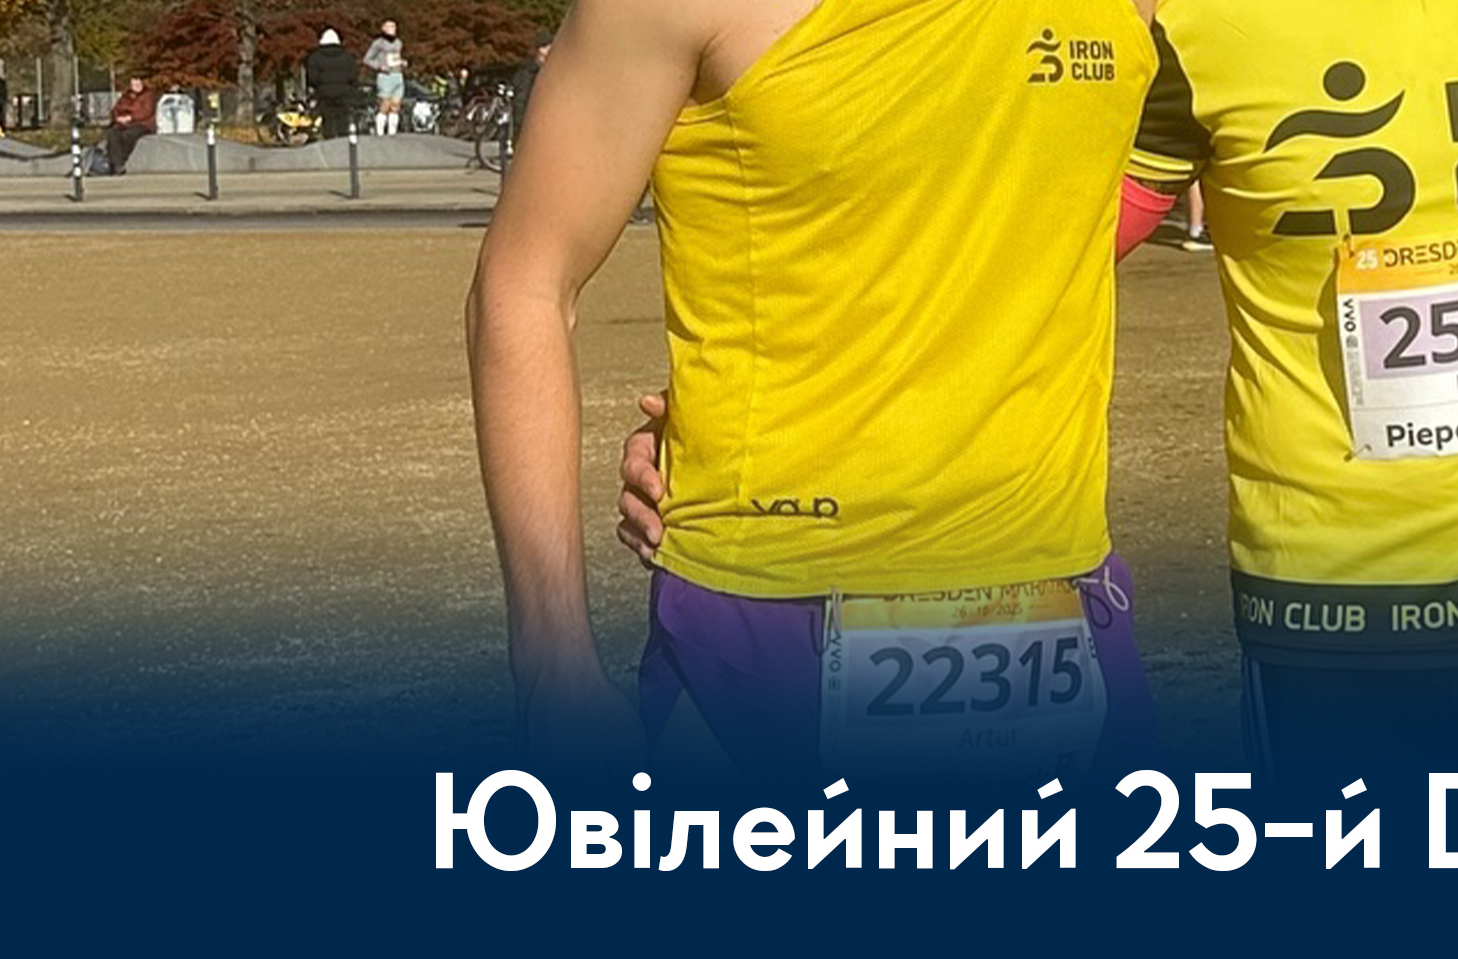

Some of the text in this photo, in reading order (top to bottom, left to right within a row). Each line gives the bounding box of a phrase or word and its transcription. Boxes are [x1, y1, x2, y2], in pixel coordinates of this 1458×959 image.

[1069, 40, 1114, 60] IRON
[1071, 62, 1115, 81] CLUB
[1239, 592, 1274, 628] RON
[1283, 601, 1367, 633] CLUB
[866, 636, 1083, 717] 22315
[958, 726, 1019, 750] Artur
